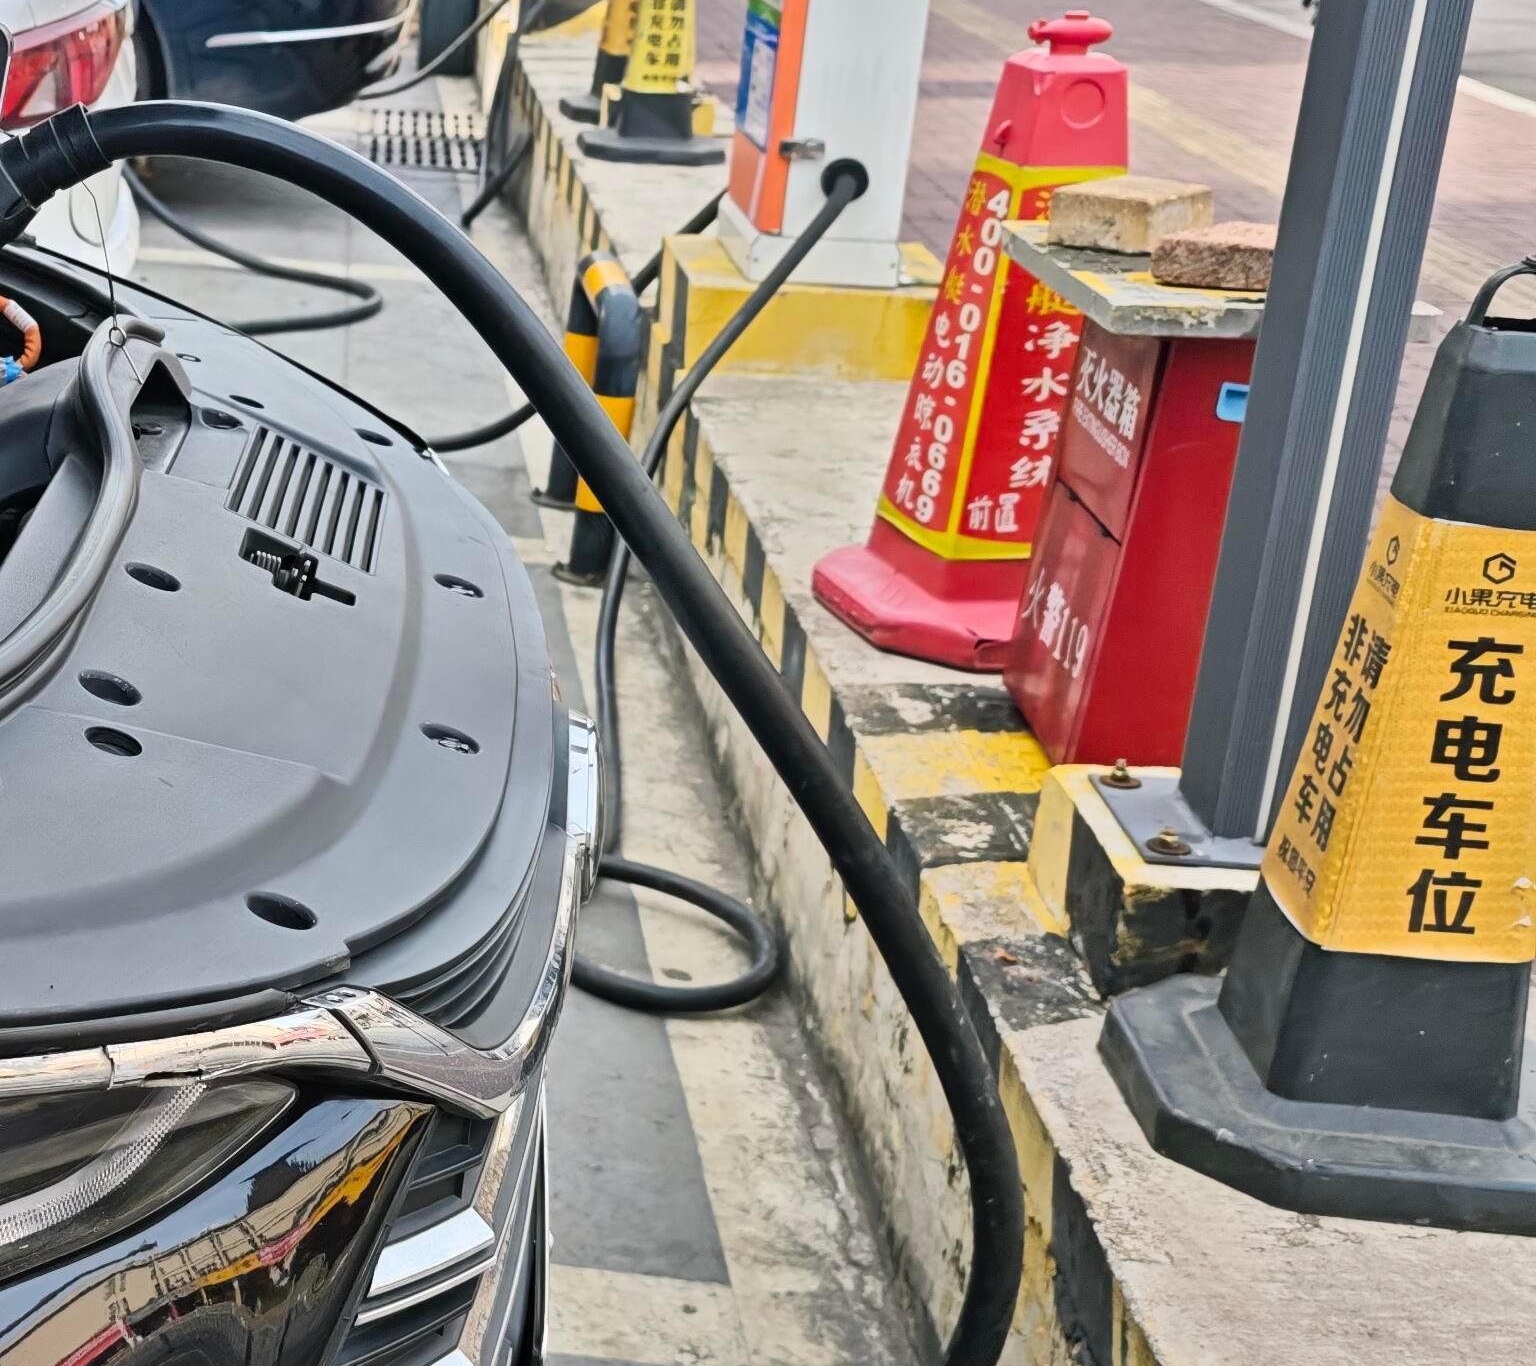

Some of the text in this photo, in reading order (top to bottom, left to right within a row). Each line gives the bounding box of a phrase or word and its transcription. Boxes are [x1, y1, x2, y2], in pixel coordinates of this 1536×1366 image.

[915, 189, 1009, 524] 400-016-0669
[1075, 345, 1142, 441] 灭火器箱
[967, 492, 1021, 533] 前置
[1021, 567, 1089, 679] 火警119
[1445, 586, 1536, 611] 小果充电
[1294, 614, 1369, 824] 非充电车
[1311, 630, 1392, 852] 请勿占用
[1406, 637, 1524, 935] 充电车位
